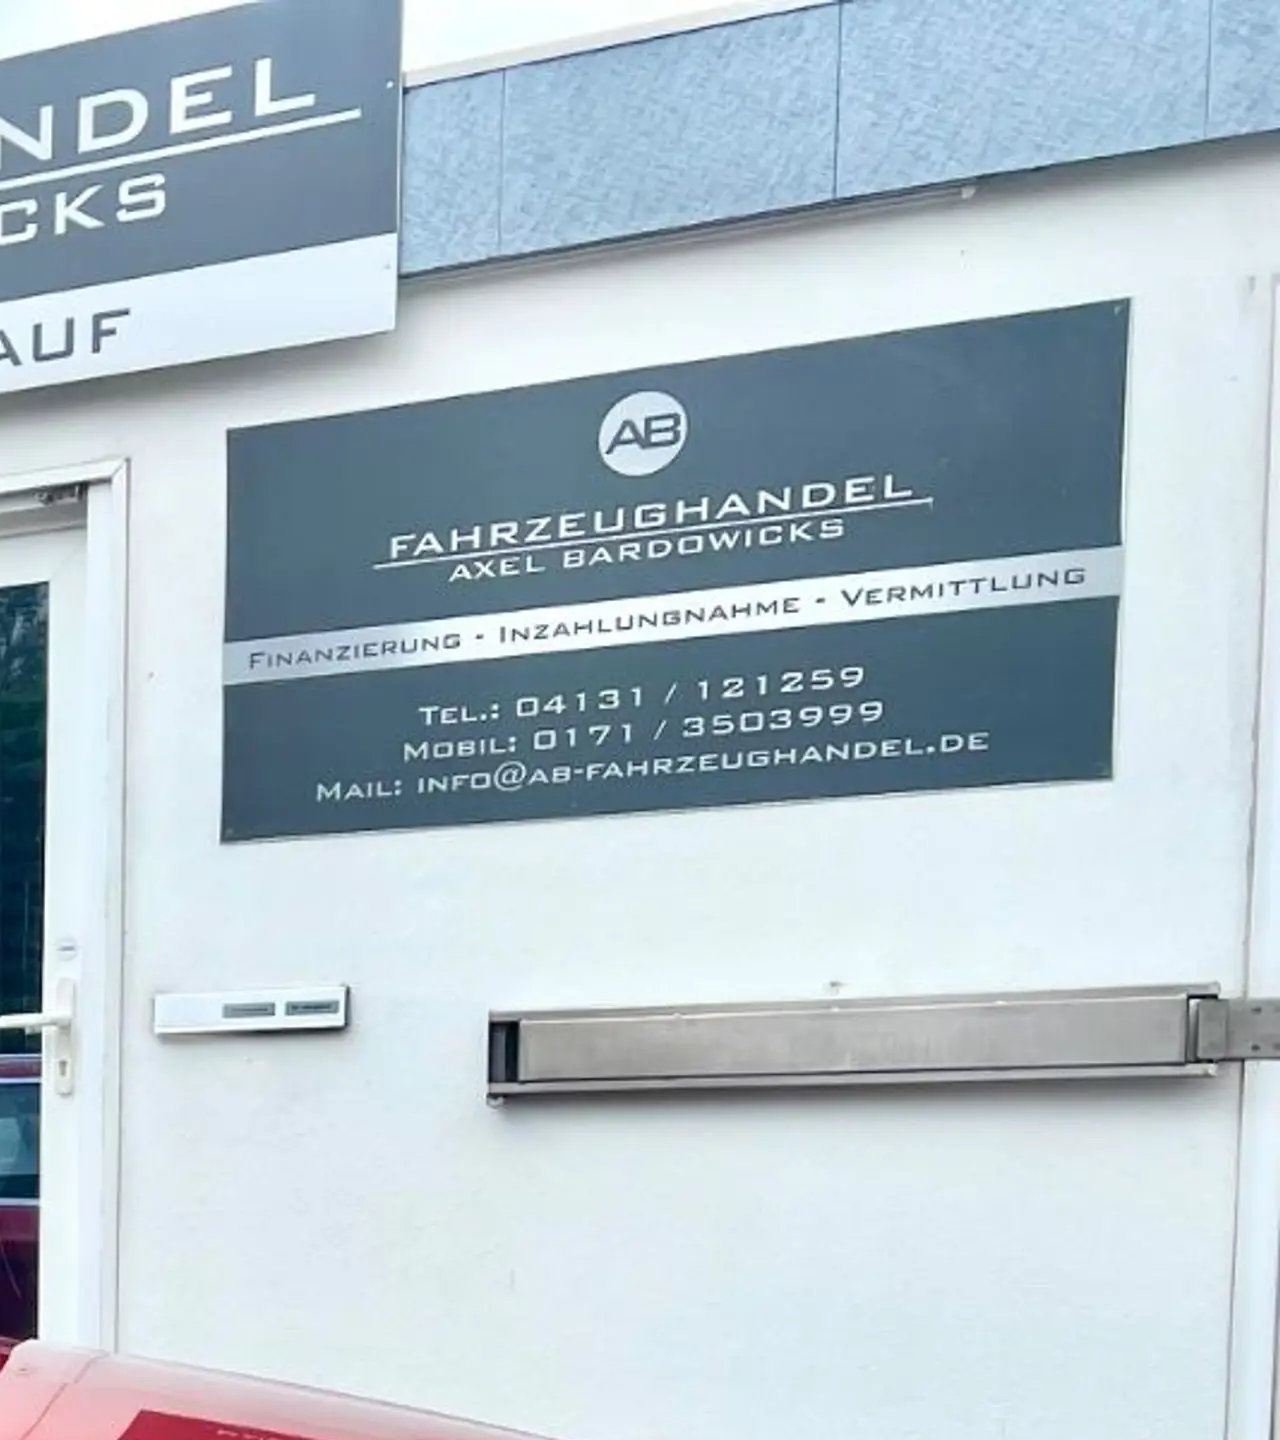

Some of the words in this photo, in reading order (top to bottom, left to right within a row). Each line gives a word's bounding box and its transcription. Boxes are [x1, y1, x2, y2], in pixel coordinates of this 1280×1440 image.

[605, 413, 681, 456] AB
[391, 473, 913, 560] FAHRZEUGHANDEL
[449, 553, 546, 582] AXEL
[564, 518, 845, 569] BARDOWICKS
[516, 685, 645, 718] 04131
[698, 665, 866, 699] 121259
[533, 722, 637, 751] 0171
[682, 700, 885, 738] 3503999
